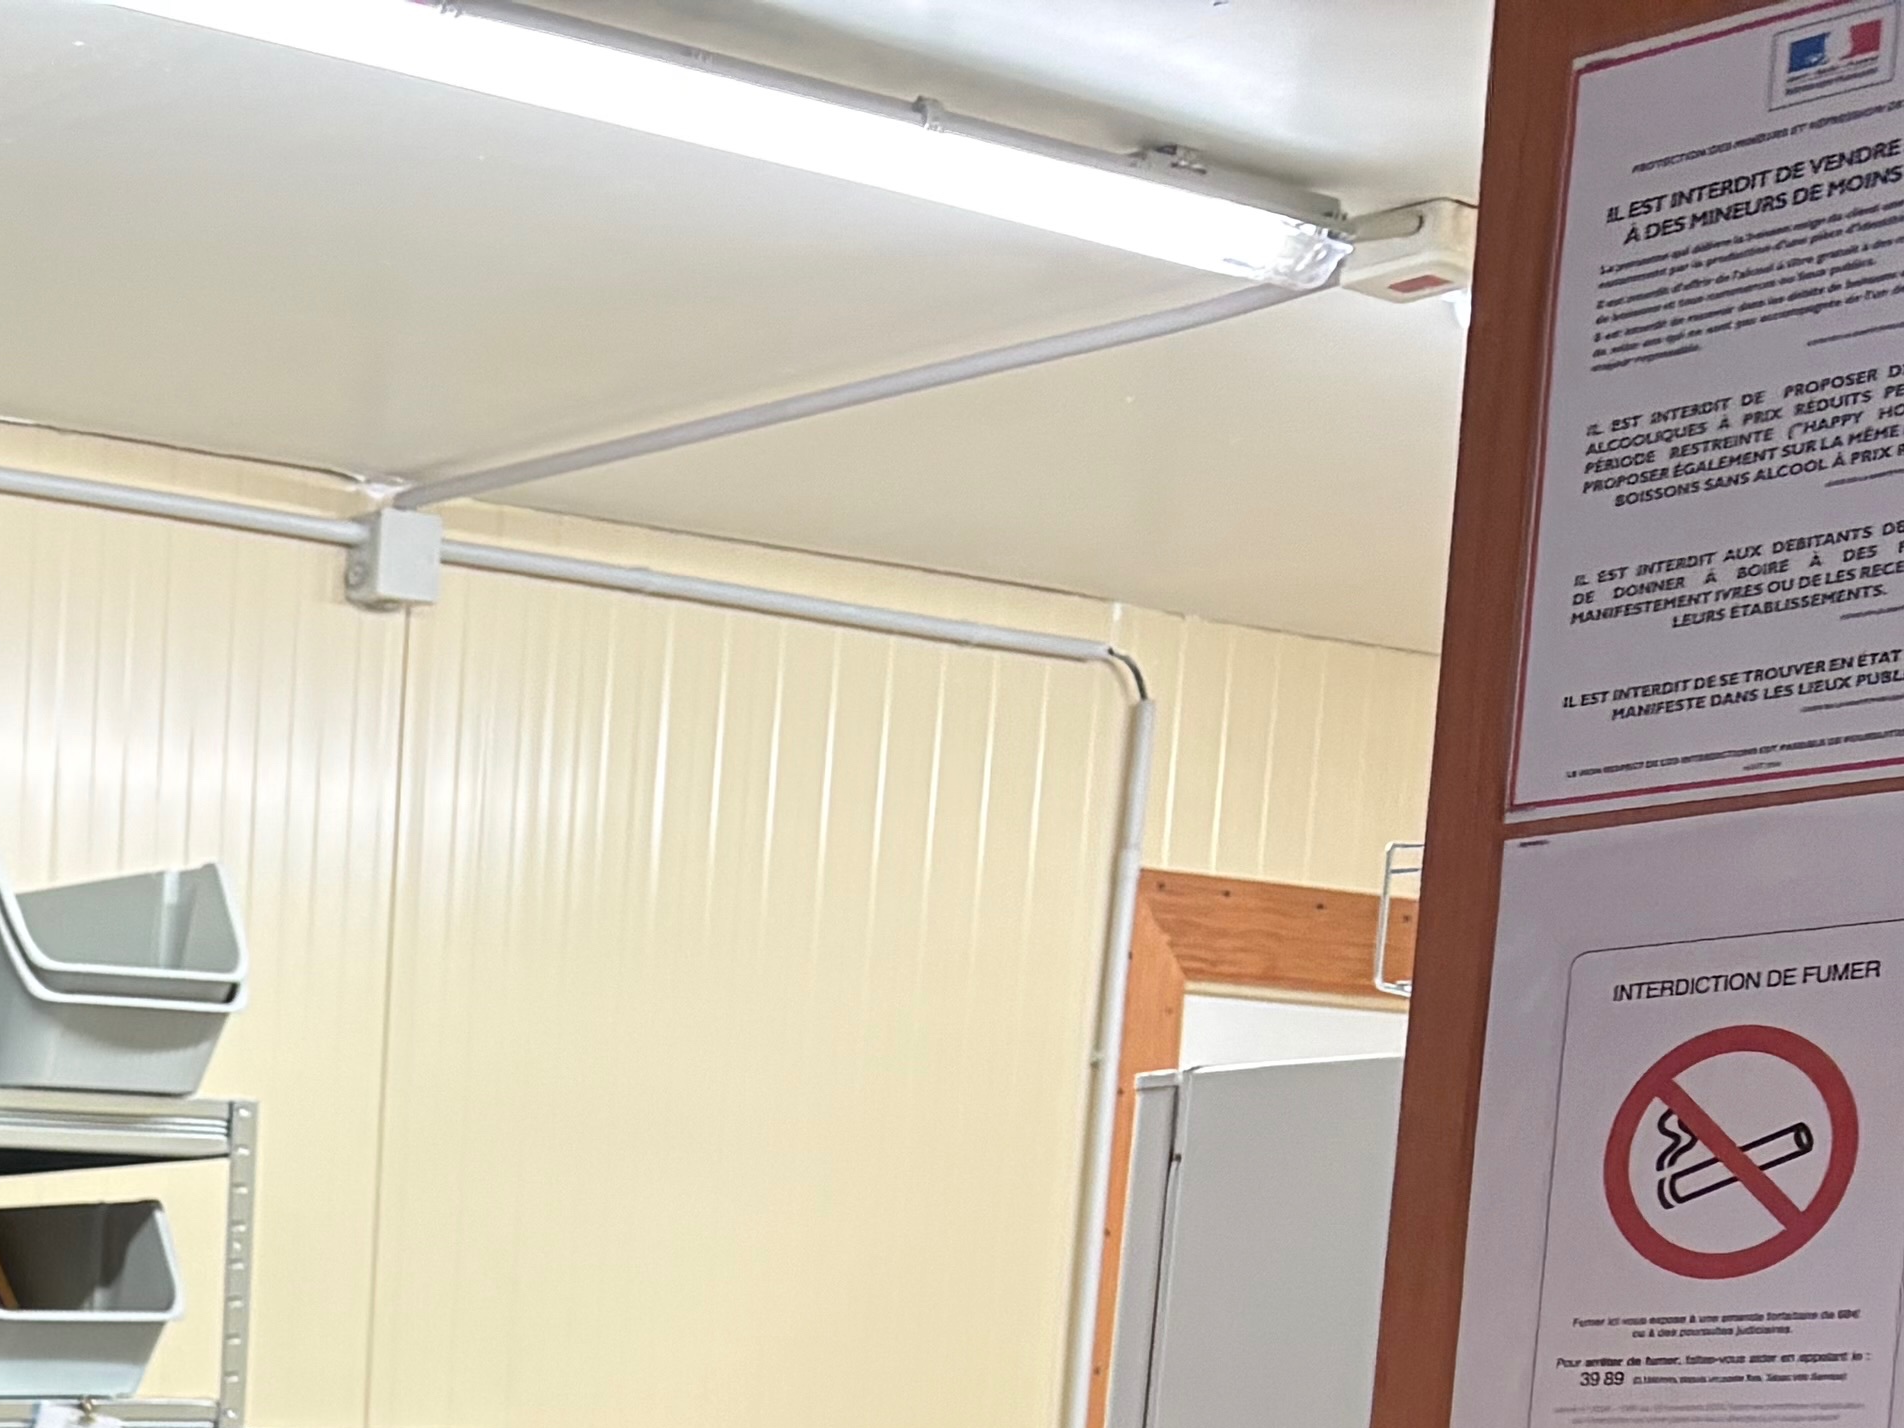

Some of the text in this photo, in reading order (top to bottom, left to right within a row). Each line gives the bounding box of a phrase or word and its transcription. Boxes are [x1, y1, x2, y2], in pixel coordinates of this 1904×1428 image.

[1607, 138, 1903, 223] IL EST INTERDIT DE VENDRE
[1644, 216, 1687, 240] DES
[1688, 191, 1788, 229] MINEURS
[1792, 183, 1824, 207] DE
[1827, 164, 1904, 199] MOINS
[1580, 691, 1610, 706] EST
[1612, 678, 1692, 701] INTERDIT
[1693, 675, 1718, 690] DE
[1719, 671, 1739, 686] SE
[1743, 660, 1826, 683] TROUVER
[1828, 656, 1854, 671] EN
[1611, 695, 1707, 721] MANIFESTE
[1710, 689, 1758, 707] DANS
[1763, 684, 1794, 699] LES
[1798, 676, 1852, 695] LIEUX
[1613, 960, 1881, 1001] INTERDICTION DE FUMER
[1579, 1372, 1601, 1387] 39
[1603, 1371, 1624, 1386] 89
